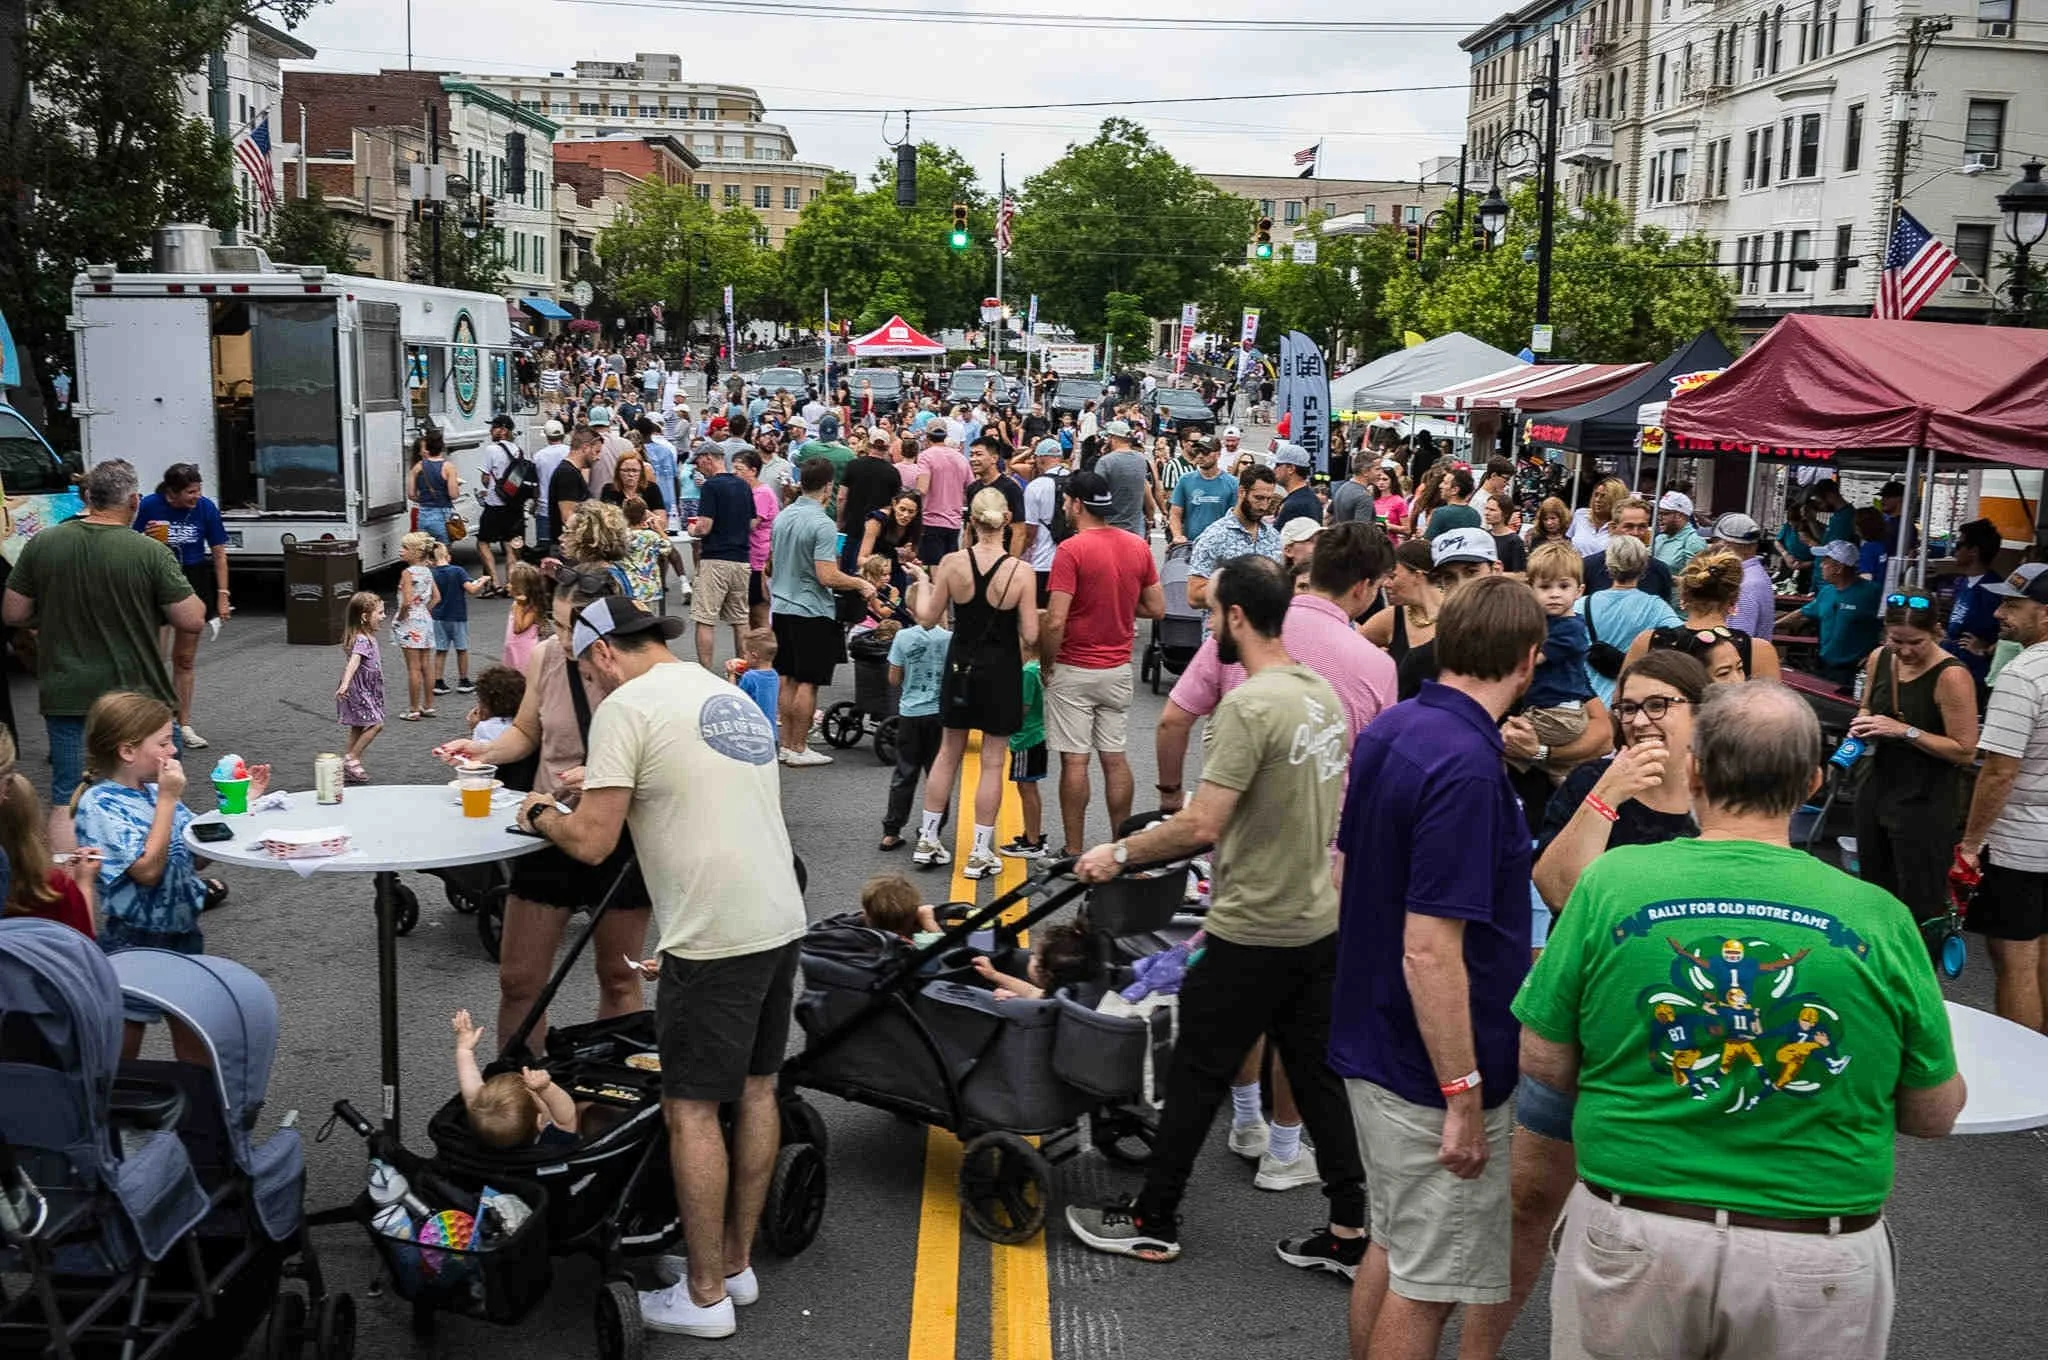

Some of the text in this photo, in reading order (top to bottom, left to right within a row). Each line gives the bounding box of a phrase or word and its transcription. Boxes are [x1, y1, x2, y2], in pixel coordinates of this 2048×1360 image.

[1674, 374, 1709, 386] THE
[1674, 433, 1715, 450] THE
[699, 720, 733, 738] SLE
[1647, 902, 1831, 930] RALLY FOR OLD NOTRE DAME
[1730, 969, 1739, 987] 1
[1733, 1015, 1748, 1030] 11
[1668, 1026, 1686, 1042] 87
[1797, 1032, 1808, 1043] 7
